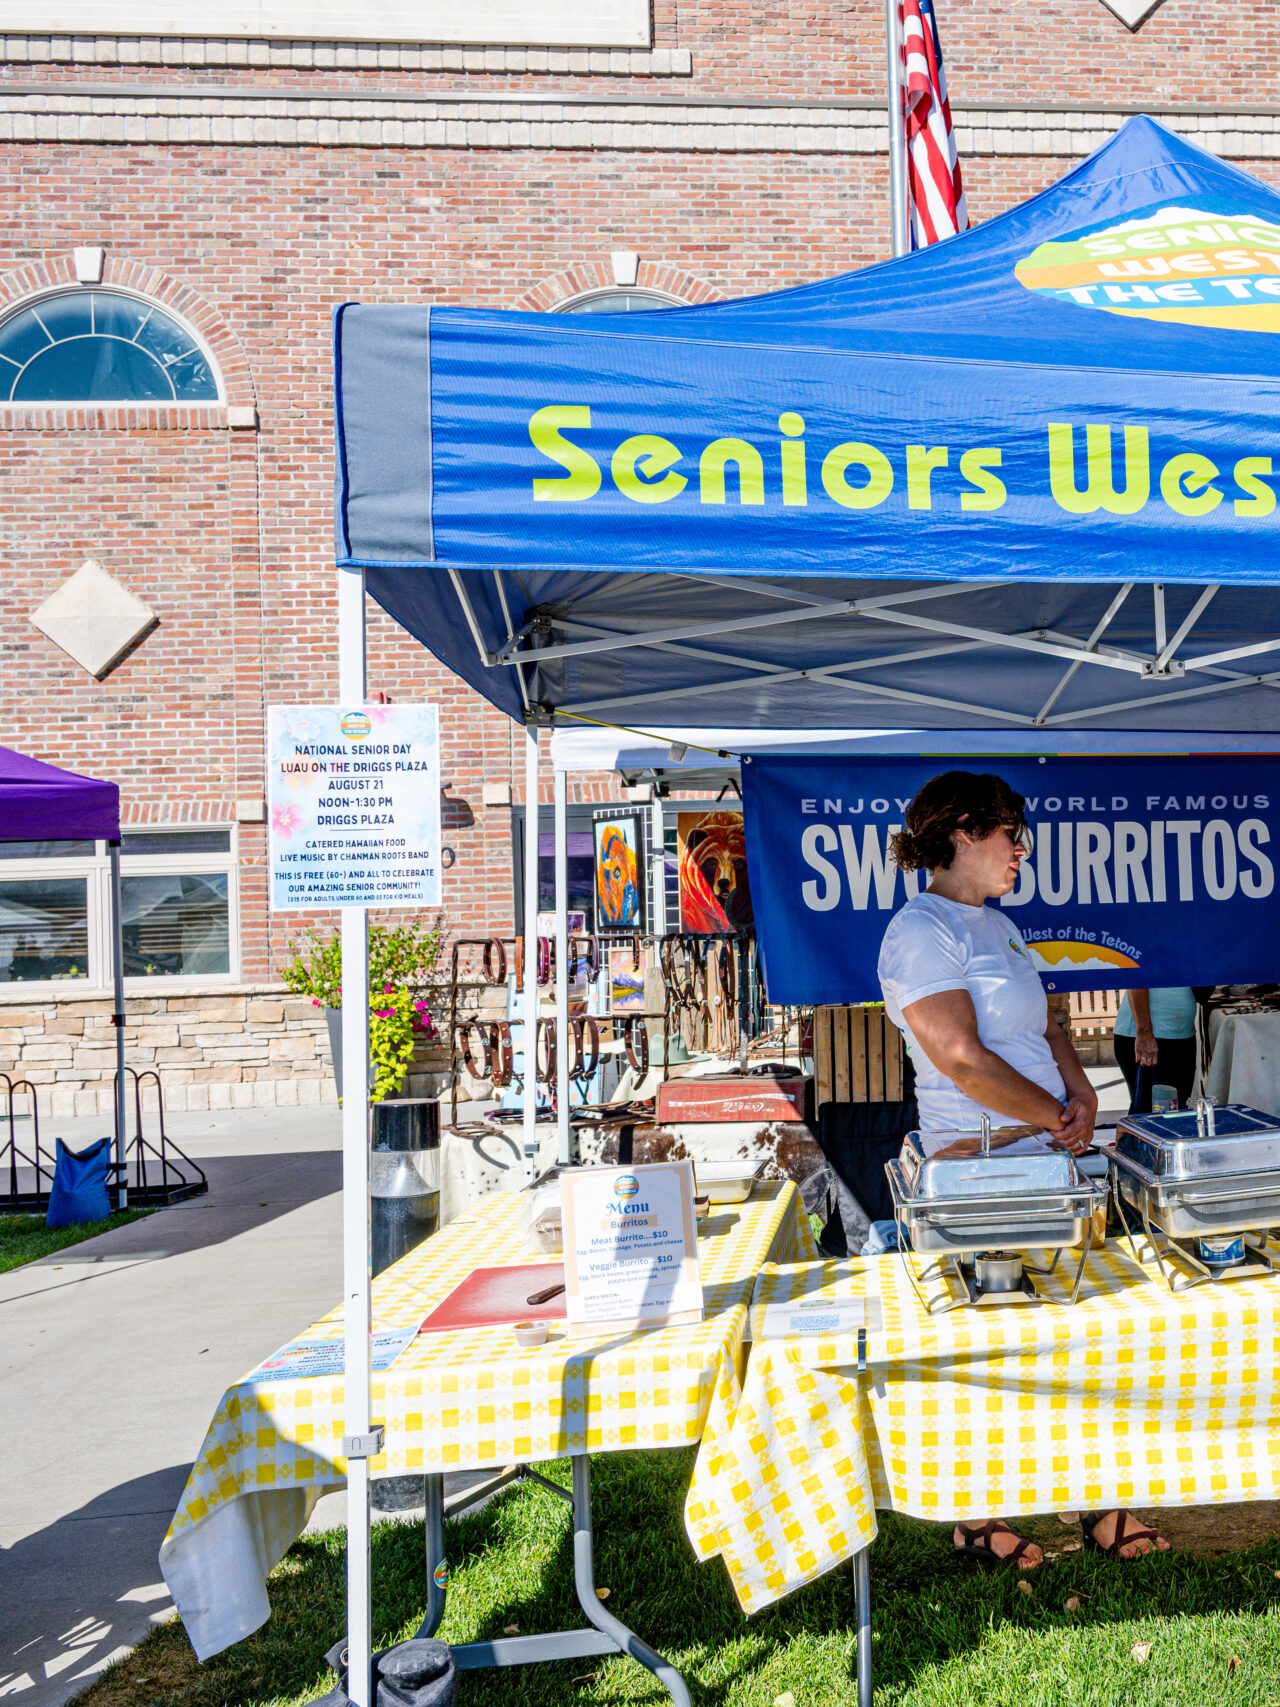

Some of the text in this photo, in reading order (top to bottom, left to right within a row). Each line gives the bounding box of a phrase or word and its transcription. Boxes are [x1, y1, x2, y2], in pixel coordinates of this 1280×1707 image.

[1055, 283, 1205, 307] THE
[528, 405, 1008, 511] Seniors
[295, 744, 411, 755] NATIONAL SENIOR DAY
[281, 761, 428, 773] LUAU ON THE DRIGGS PLAZA
[328, 780, 384, 790] AUGUST 21
[318, 797, 392, 807] NOON-1:30 PM
[801, 798, 911, 814] ENJOY
[1146, 794, 1271, 811] FAMOUS
[317, 815, 394, 825] DRIGGS PLAZA
[306, 839, 405, 848] CATERED HAWAIIAN FOOD
[281, 853, 298, 861] LIVE
[300, 853, 325, 861] MUSIC
[328, 853, 338, 861] BY
[340, 852, 380, 860] CHANMAN
[382, 852, 406, 860] ROOTS
[1000, 818, 1275, 906] BURRITOS
[275, 872, 292, 880] THIS
[294, 872, 302, 880] IS
[304, 871, 324, 879] FREE
[349, 870, 365, 878] AND
[367, 870, 379, 878] ALL
[382, 870, 391, 878] TO
[393, 869, 434, 877] CELEBRATE
[308, 884, 344, 892] AMAZING
[346, 883, 374, 891] SENIOR
[377, 882, 421, 890] COMMUNITY!
[1057, 926, 1072, 940] of
[1075, 926, 1097, 942] the
[1100, 930, 1142, 960] Tetons
[605, 1201, 650, 1216] Menu
[611, 1219, 648, 1228] Burritos
[591, 1237, 612, 1245] Meat
[589, 1263, 617, 1271] Veggie
